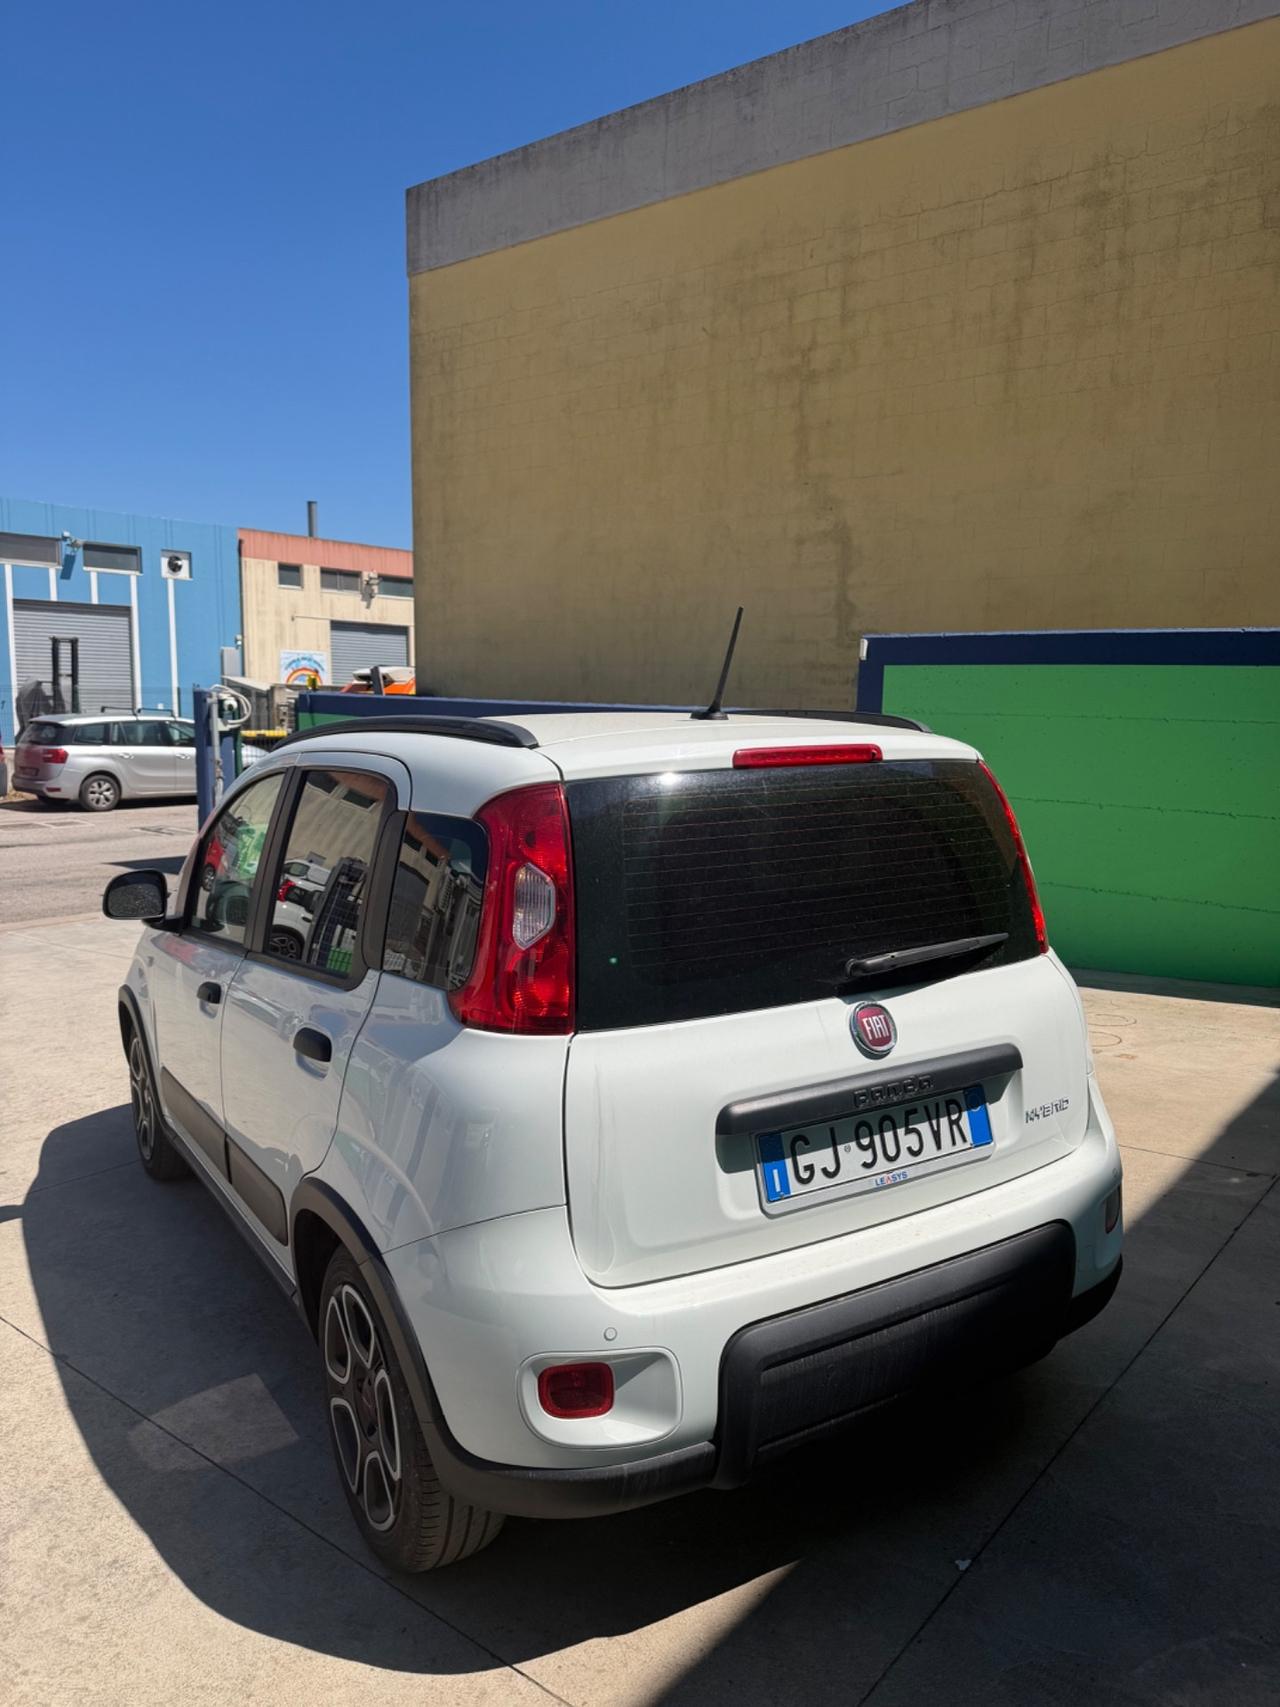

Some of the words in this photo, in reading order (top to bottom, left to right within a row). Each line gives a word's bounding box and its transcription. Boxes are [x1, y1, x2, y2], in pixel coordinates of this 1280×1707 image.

[862, 1014, 890, 1040] FIAT
[790, 1126, 841, 1185] GJ
[854, 1098, 968, 1169] 905VR
[875, 1171, 908, 1186] LEASYS
